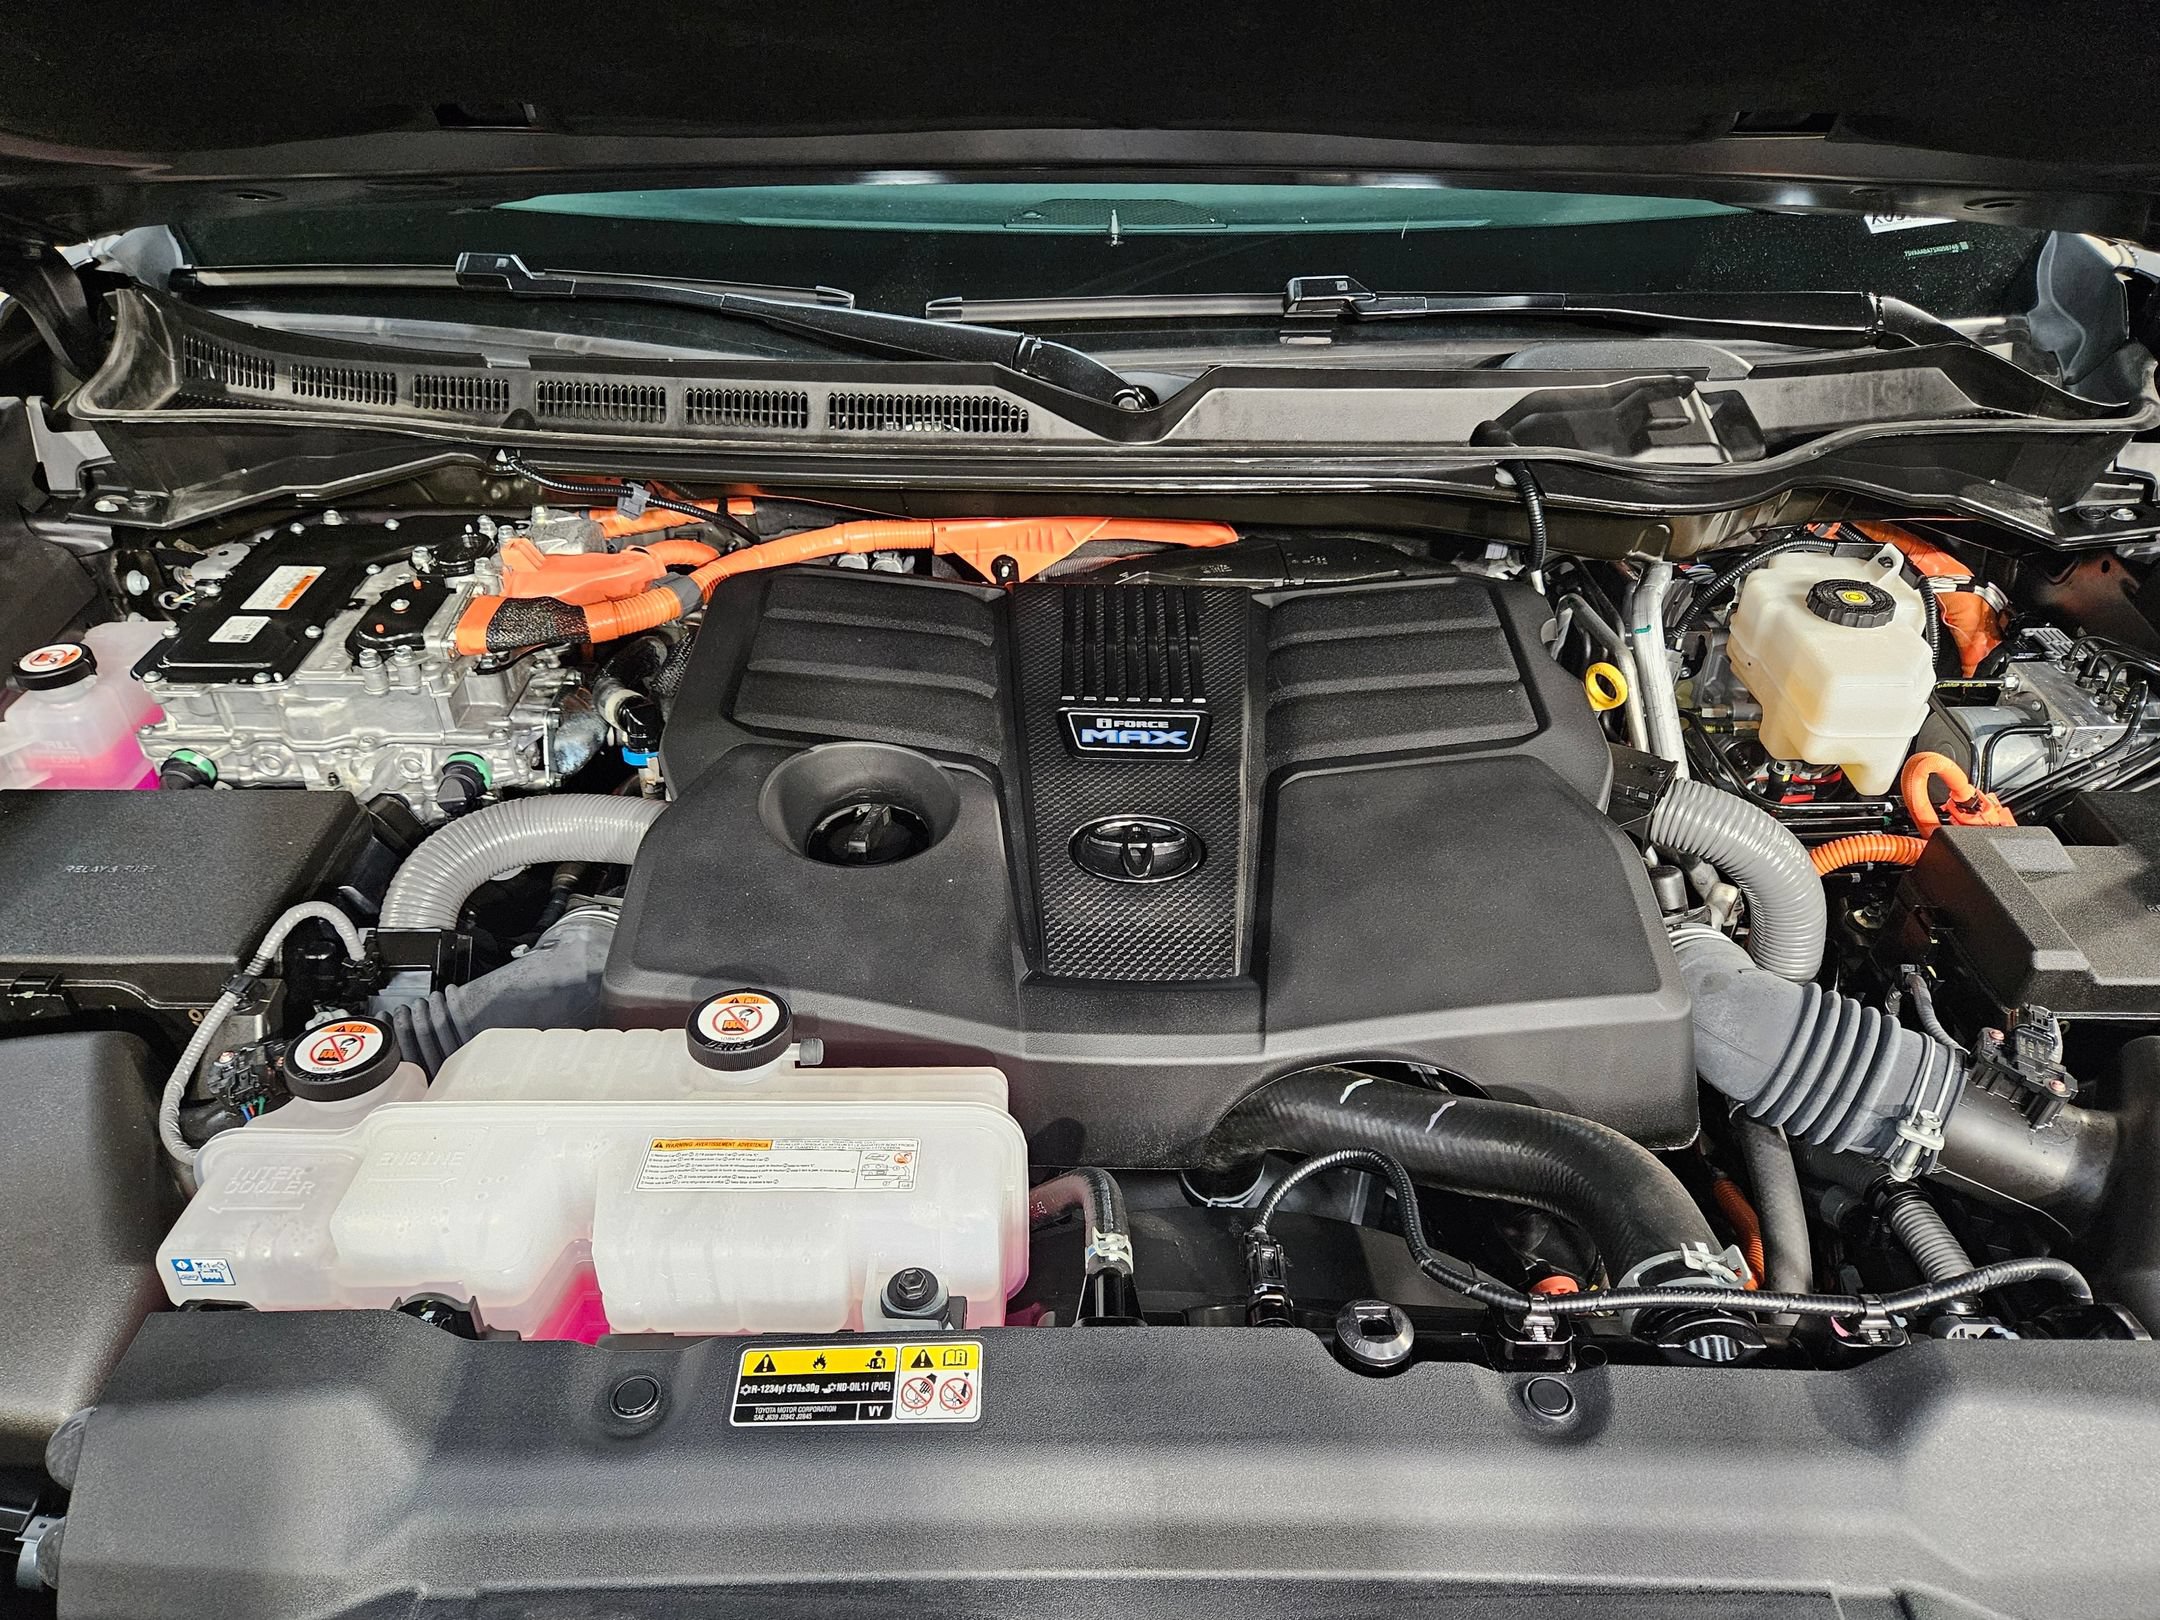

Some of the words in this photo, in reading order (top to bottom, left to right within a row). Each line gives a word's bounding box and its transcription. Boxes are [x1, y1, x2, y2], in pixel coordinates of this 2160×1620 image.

[1113, 720, 1169, 729] FORCE
[1081, 728, 1188, 745] MAX
[377, 1151, 465, 1167] ENGINE
[230, 1166, 308, 1181] INTER
[223, 1180, 316, 1195] COOLER
[751, 1384, 786, 1395] R-1234yf
[787, 1383, 820, 1394] 970±30g
[870, 1381, 891, 1392] (POE)
[755, 1406, 777, 1414] TOYOTA
[777, 1406, 798, 1414] MOTOR
[797, 1405, 838, 1413] CORPORATION
[867, 1405, 884, 1417] VY
